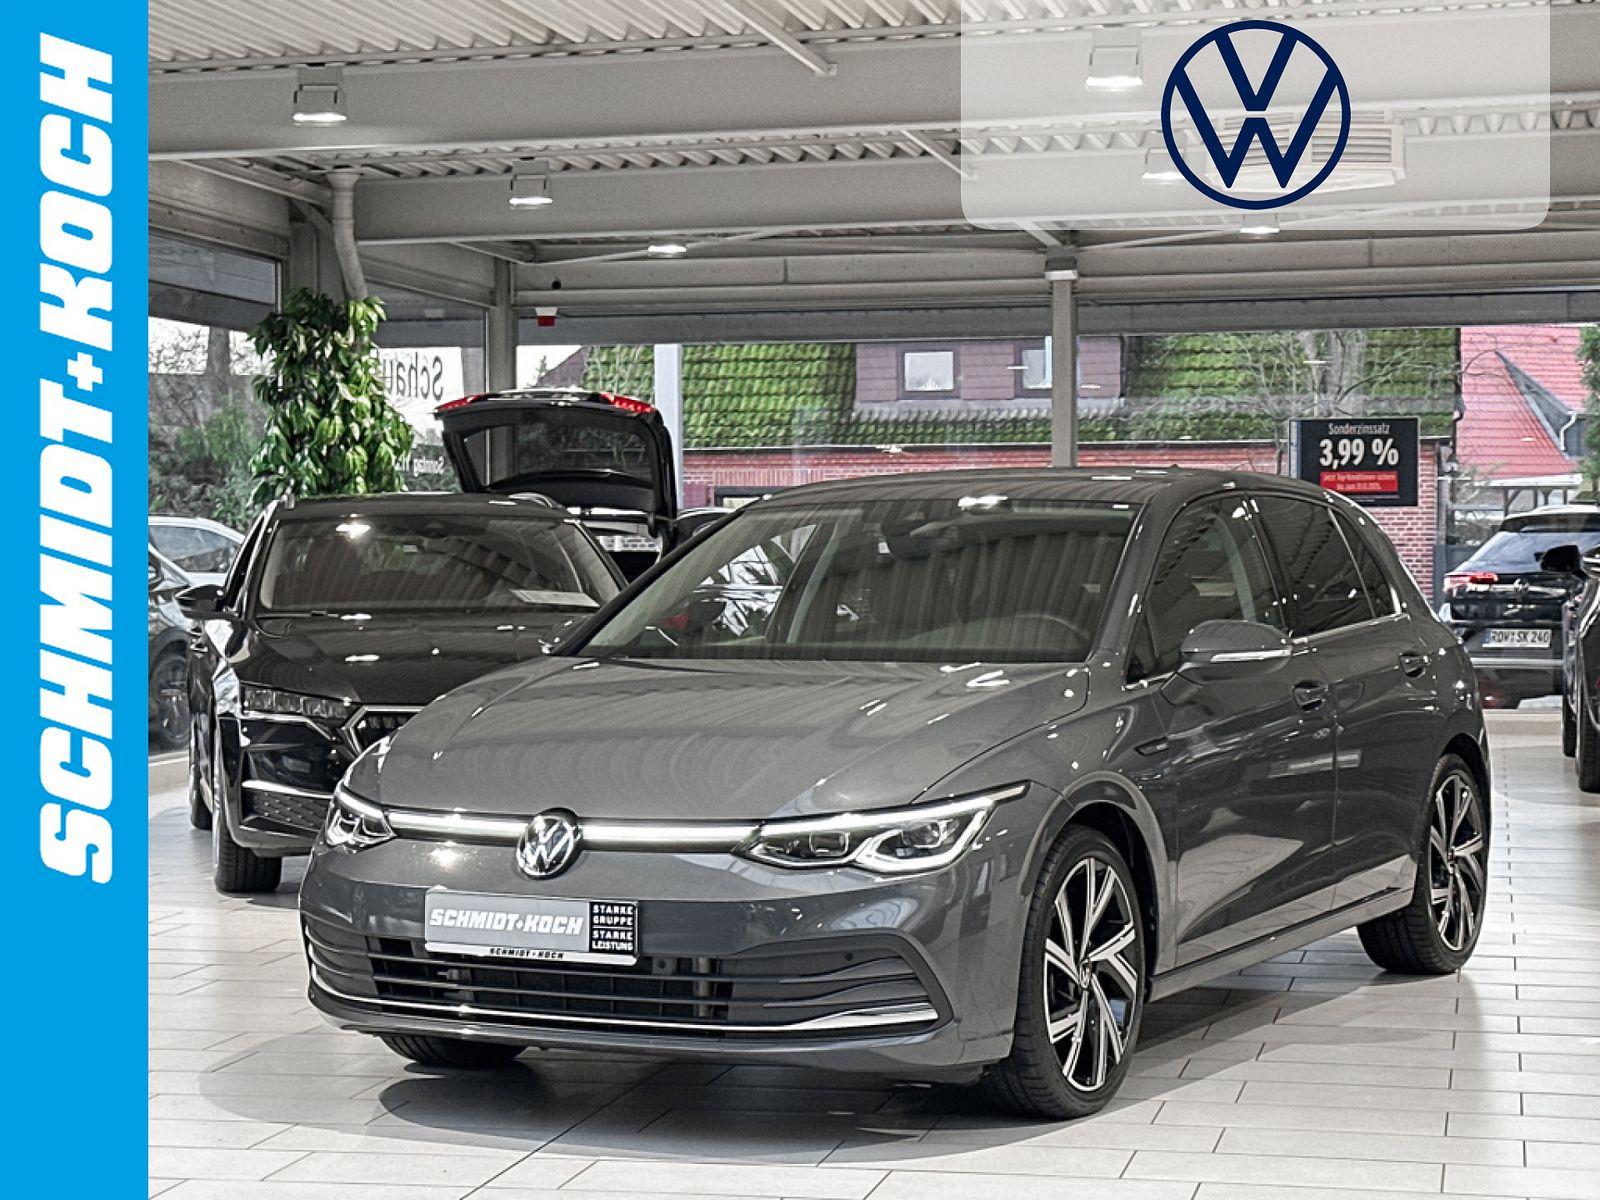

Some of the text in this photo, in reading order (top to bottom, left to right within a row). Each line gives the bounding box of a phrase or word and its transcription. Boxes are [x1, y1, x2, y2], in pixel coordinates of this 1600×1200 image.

[1328, 422, 1391, 435] Sonderzinssatz
[1319, 438, 1399, 470] 3,99 %
[592, 904, 634, 915] STARKE
[429, 908, 585, 936] SCHMIDT+KOCH
[592, 915, 634, 926] GRUPPE
[592, 930, 634, 941] STARKE
[591, 940, 634, 951] LEISTUNG
